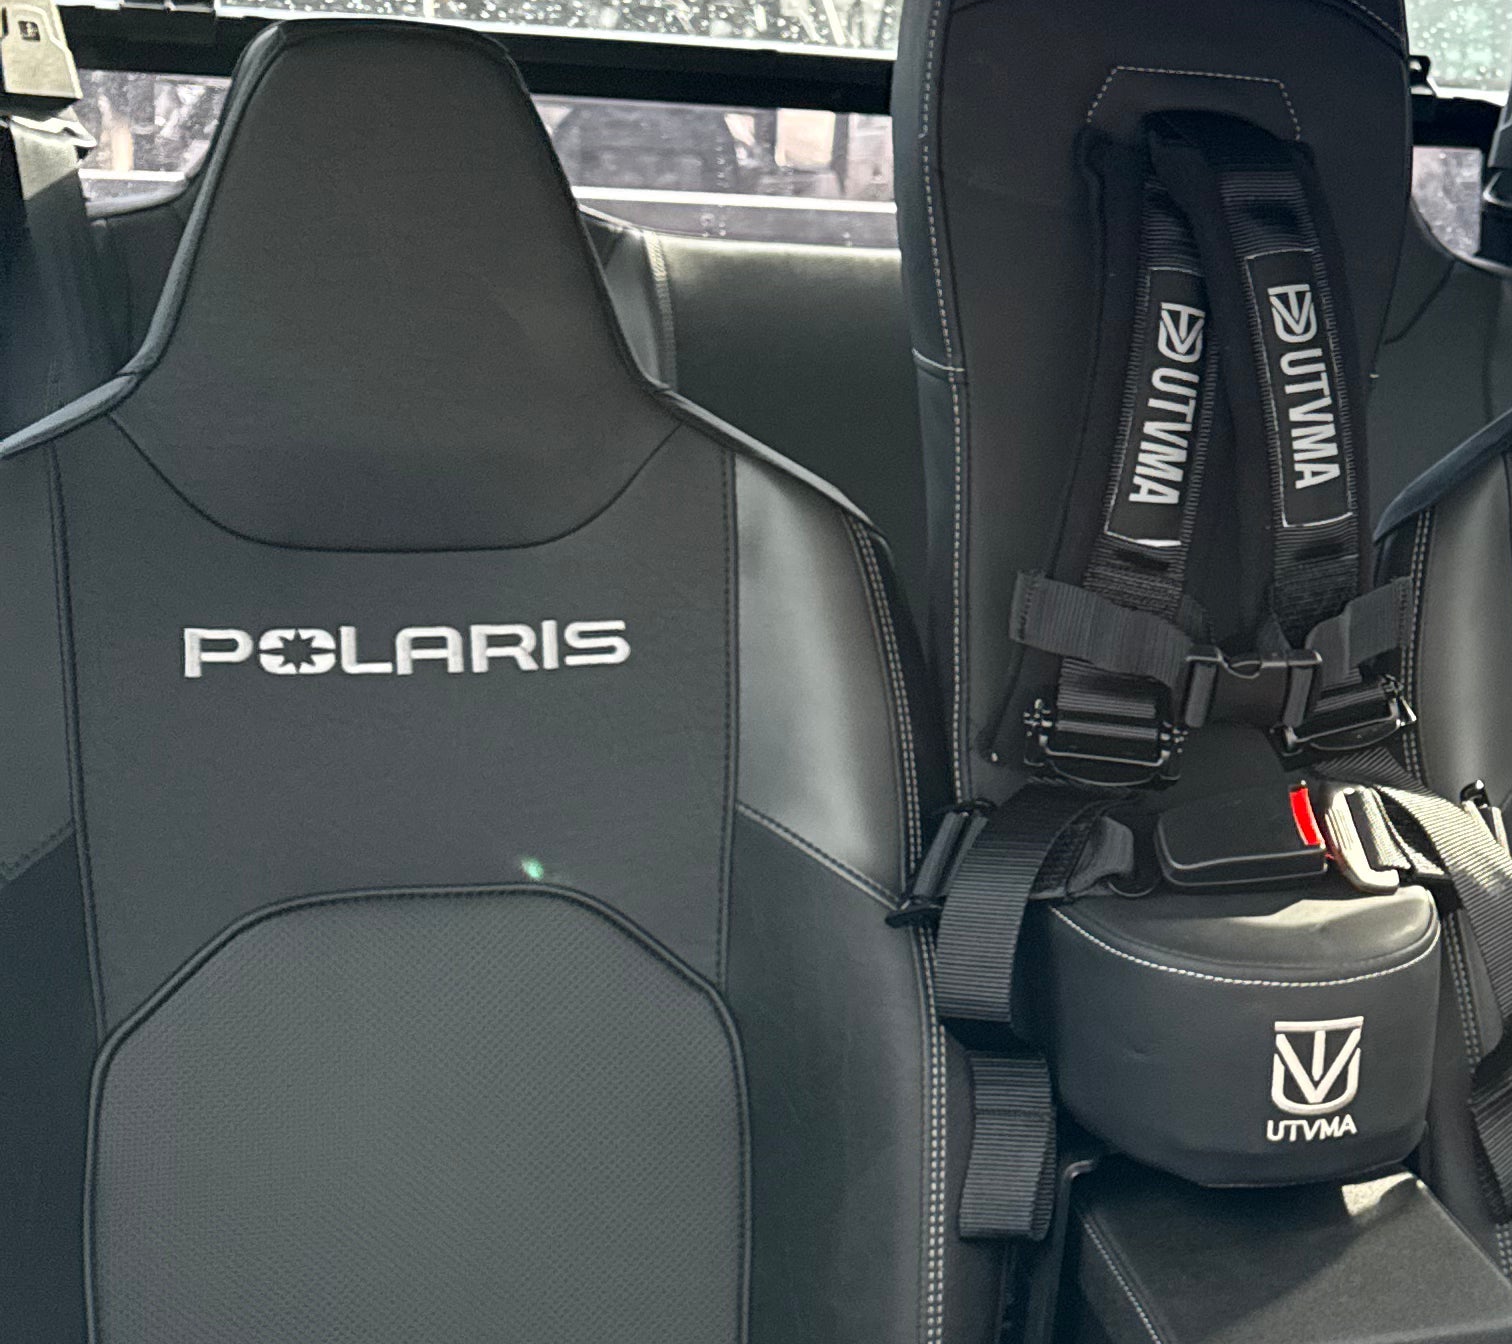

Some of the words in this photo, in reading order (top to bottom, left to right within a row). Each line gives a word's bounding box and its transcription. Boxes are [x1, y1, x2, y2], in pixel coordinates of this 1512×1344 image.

[1128, 367, 1199, 504] UTVMA
[1280, 348, 1341, 489] UTVMA
[183, 619, 632, 678] POLARIS
[1266, 1113, 1358, 1142] UTVMA
